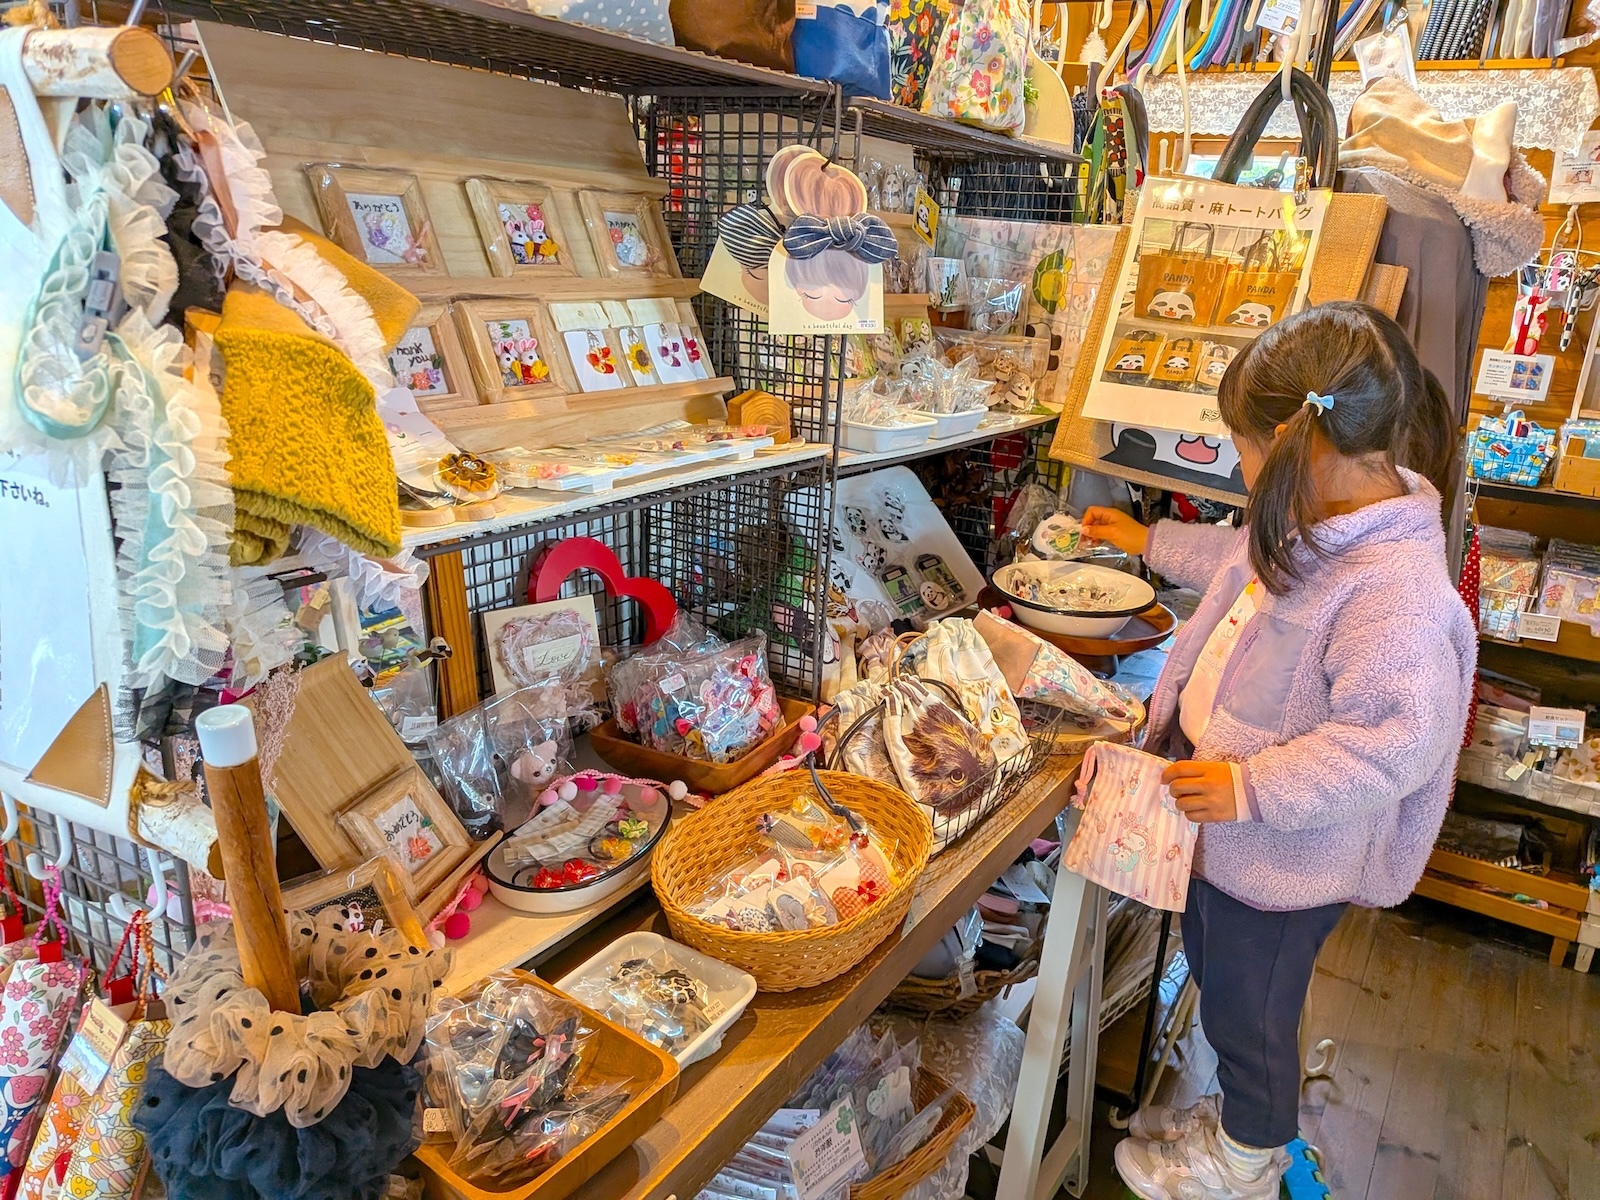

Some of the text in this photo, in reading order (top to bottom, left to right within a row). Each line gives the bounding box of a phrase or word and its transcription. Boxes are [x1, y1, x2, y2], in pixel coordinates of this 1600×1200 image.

[353, 200, 400, 213] ありがとう
[1163, 273, 1196, 285] PANDA
[1246, 285, 1276, 295] PANDA
[534, 649, 575, 668] Love
[384, 810, 419, 842] おめでとう
